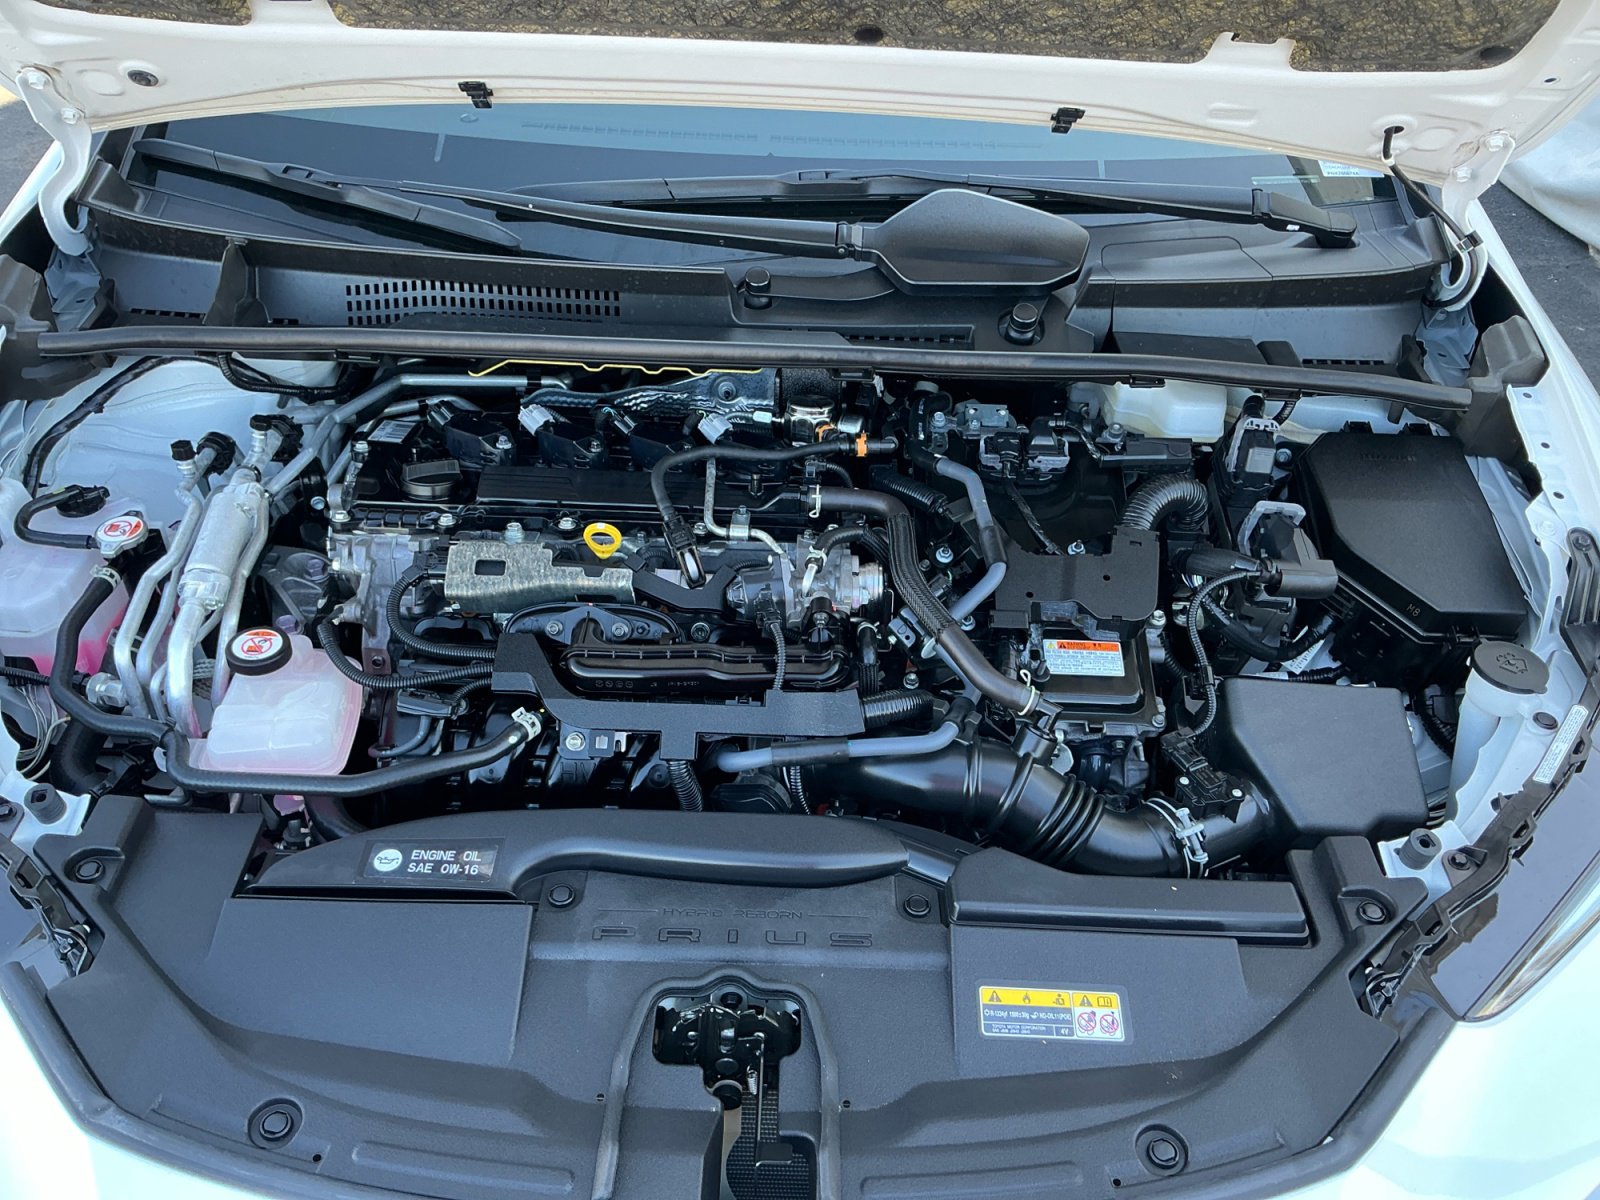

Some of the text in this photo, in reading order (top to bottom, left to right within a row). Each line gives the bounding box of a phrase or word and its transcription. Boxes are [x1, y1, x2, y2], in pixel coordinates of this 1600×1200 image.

[411, 850, 481, 862] ENGINE OIL
[407, 863, 479, 875] SAE 0W-16
[663, 907, 802, 920] HYBRID REBORN
[592, 926, 873, 947] PRIUS
